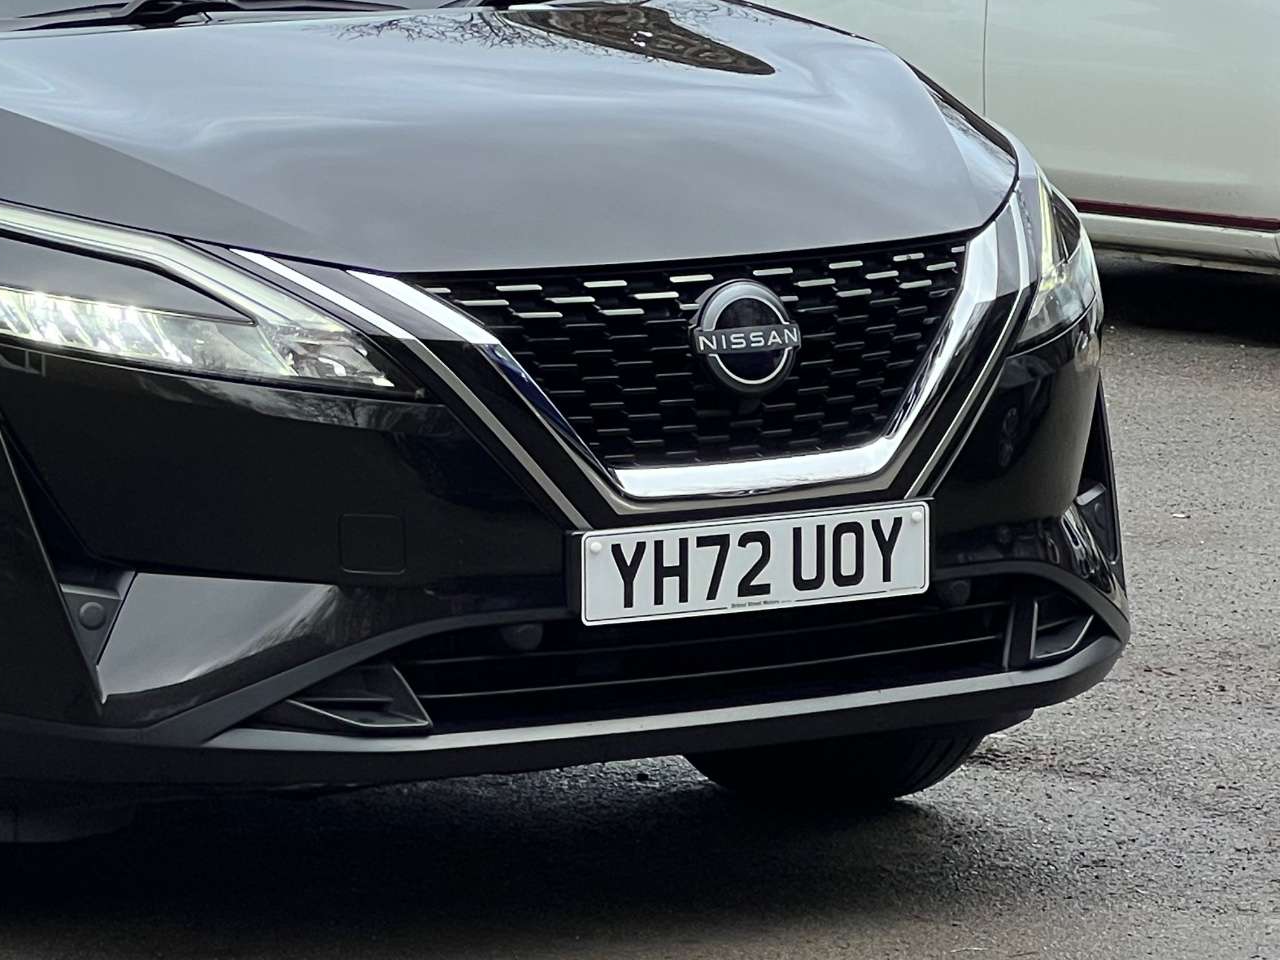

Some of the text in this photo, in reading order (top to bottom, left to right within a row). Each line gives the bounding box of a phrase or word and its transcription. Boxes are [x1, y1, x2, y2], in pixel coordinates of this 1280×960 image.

[698, 327, 798, 351] NISSAN
[610, 516, 903, 608] YH72 UOY
